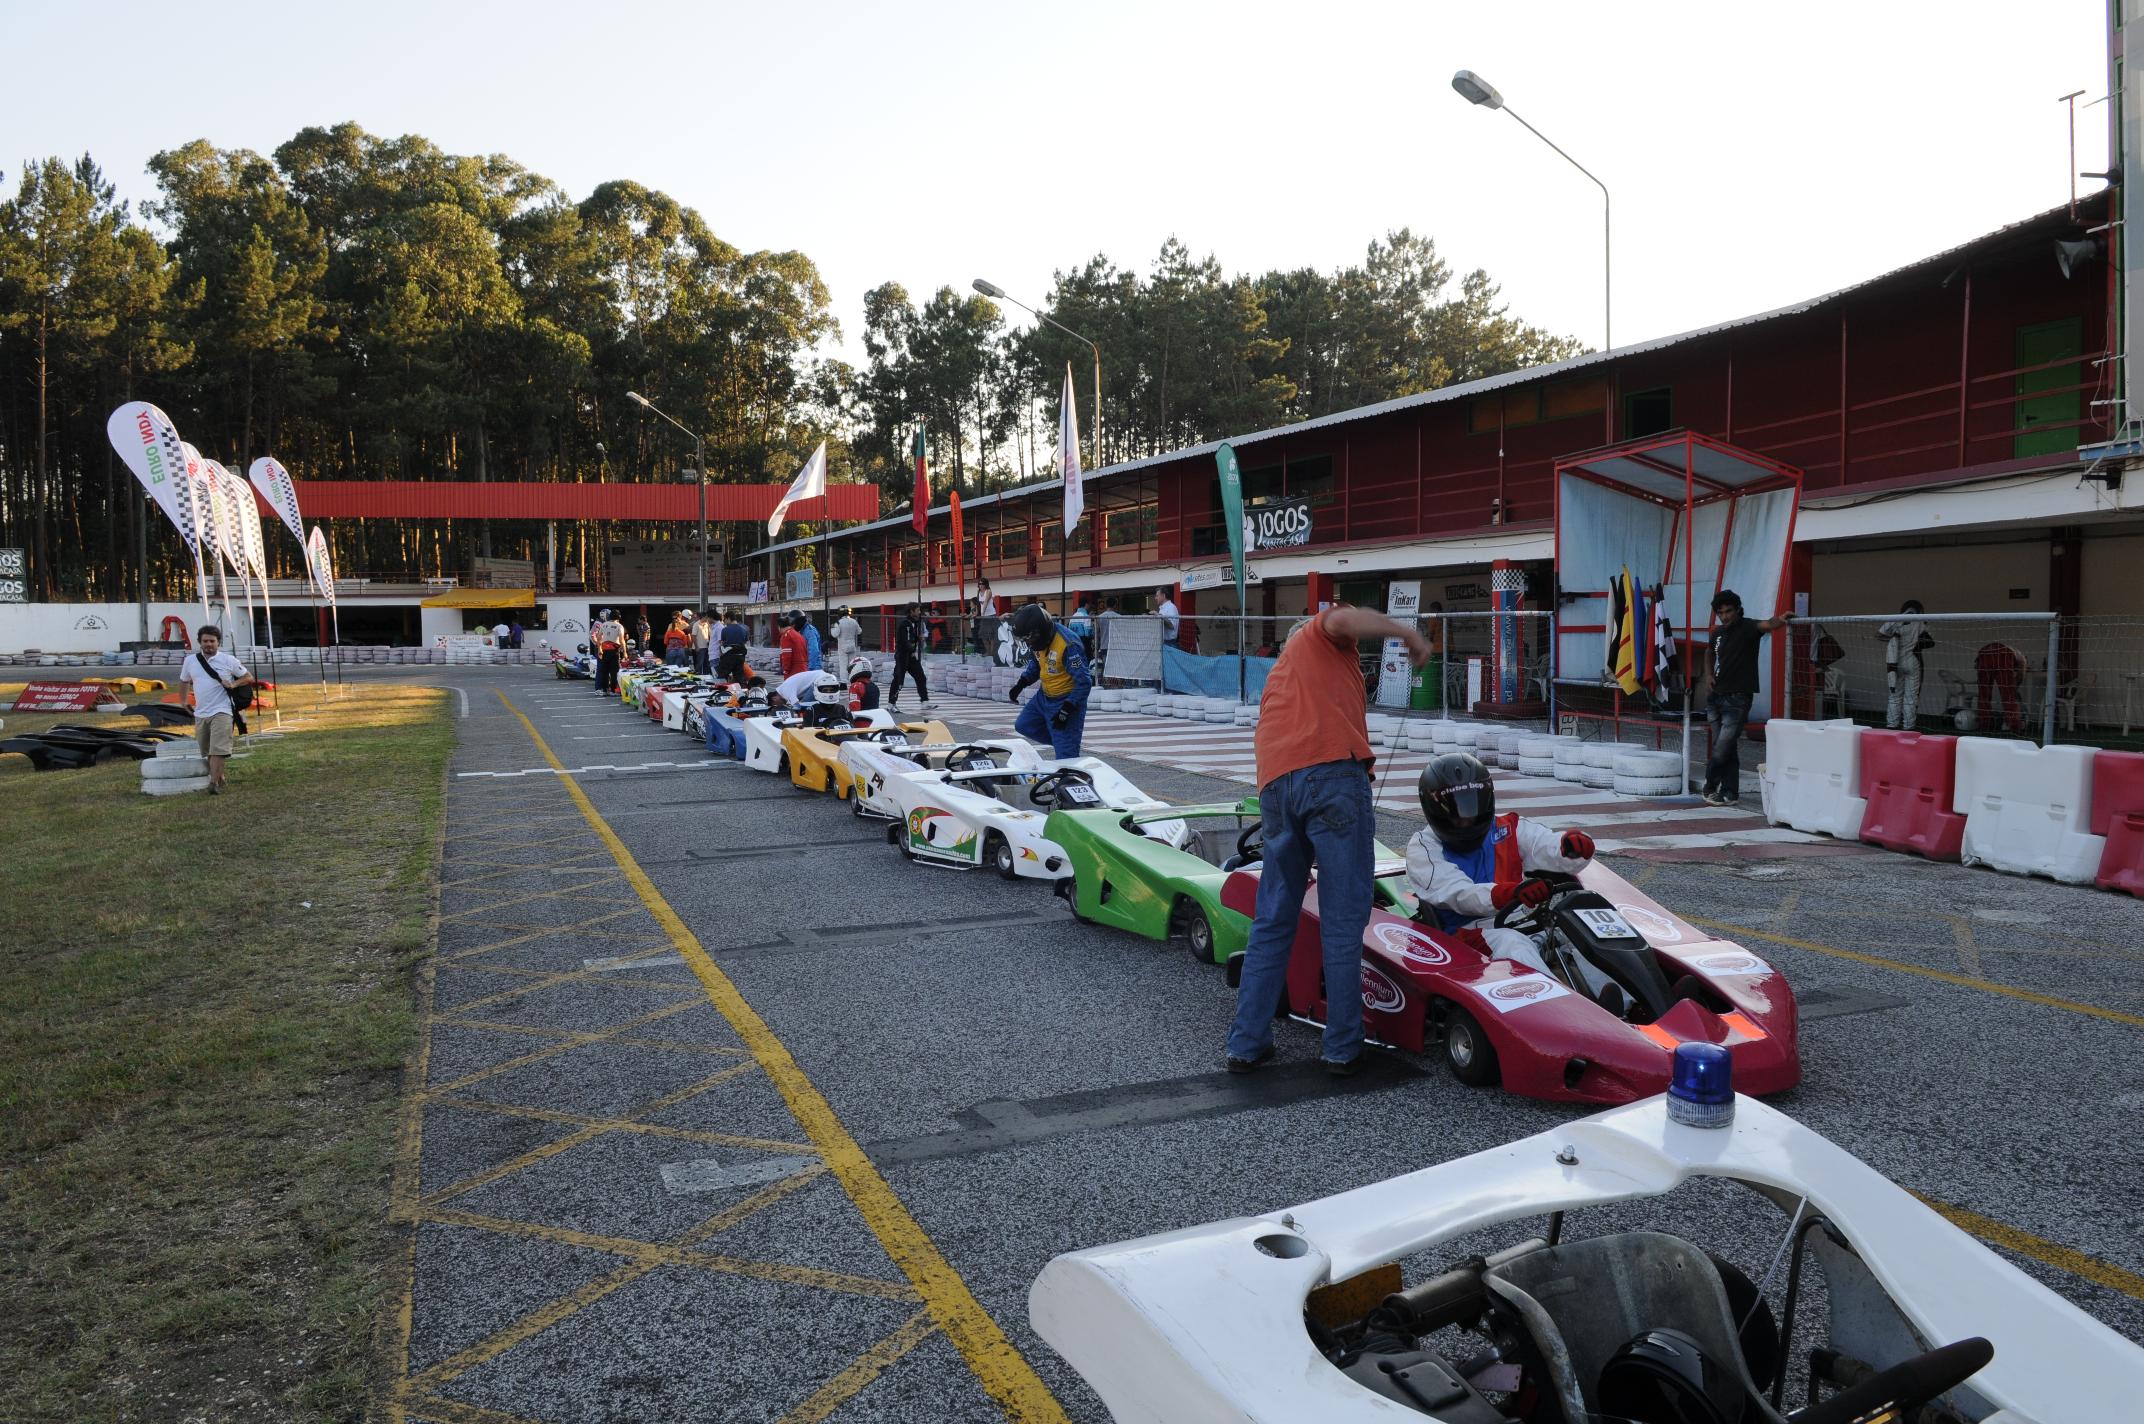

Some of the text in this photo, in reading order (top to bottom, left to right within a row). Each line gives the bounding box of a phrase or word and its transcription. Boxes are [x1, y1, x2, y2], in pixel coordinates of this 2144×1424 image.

[1257, 504, 1309, 547] JOGOS
[1440, 784, 1468, 796] clube
[1583, 910, 1616, 924] 10
[1361, 972, 1394, 999] llennium
